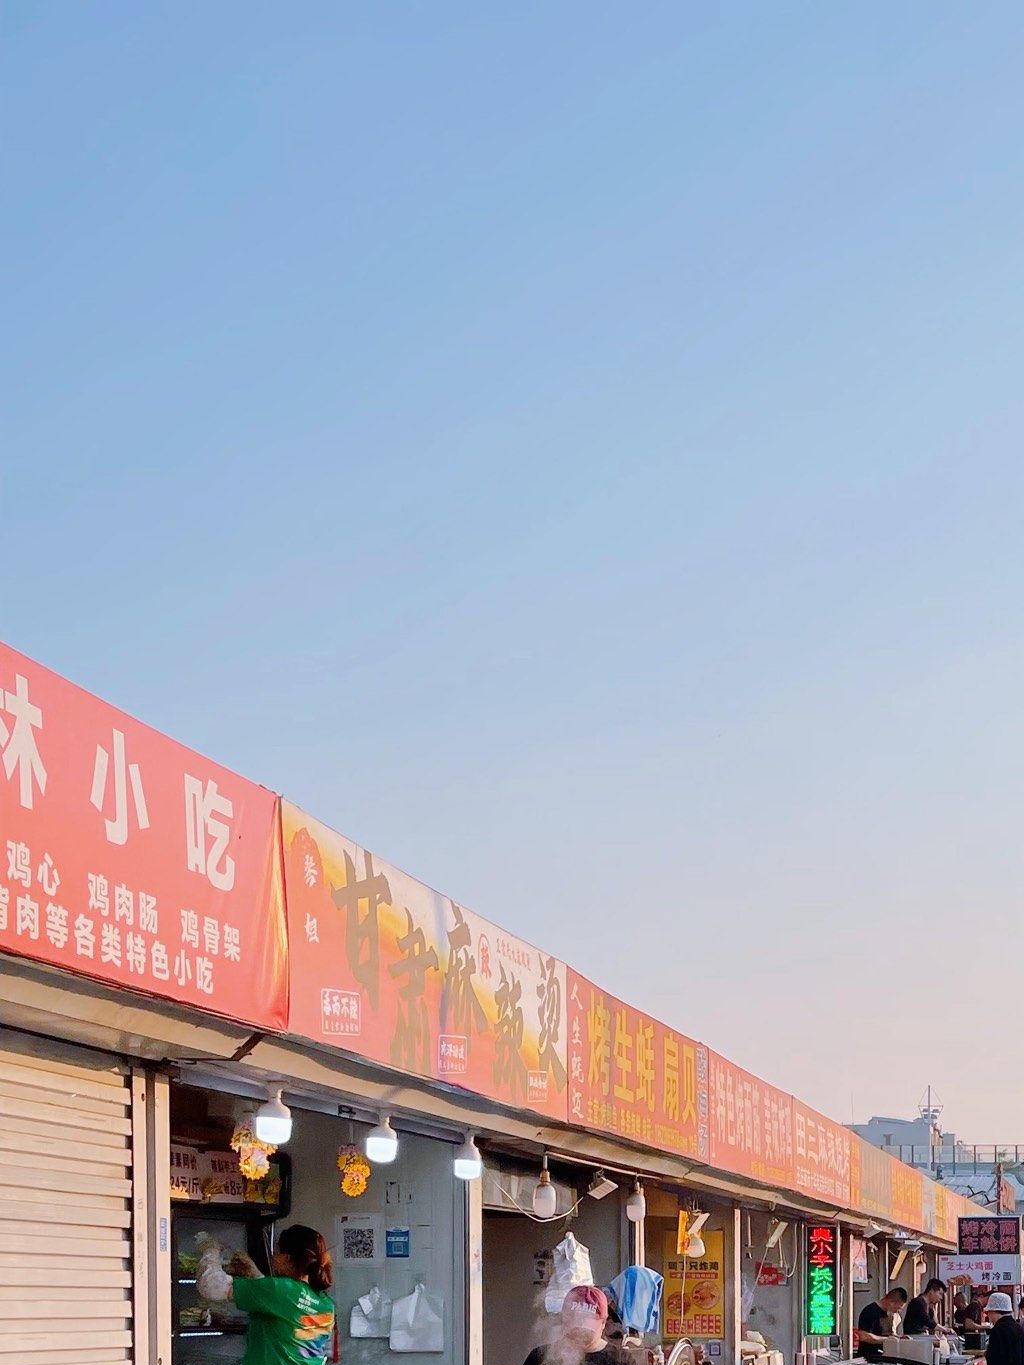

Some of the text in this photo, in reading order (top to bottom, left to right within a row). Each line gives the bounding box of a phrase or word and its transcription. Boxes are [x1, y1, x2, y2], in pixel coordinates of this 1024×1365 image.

[6, 839, 241, 962] 鸡心 鸡肉肠 鸡骨架
[587, 990, 655, 1113] 烤生蚝
[663, 1033, 697, 1127] 扇贝
[946, 1261, 993, 1271] 芝士火鸡面
[570, 1301, 598, 1313] PARIS
